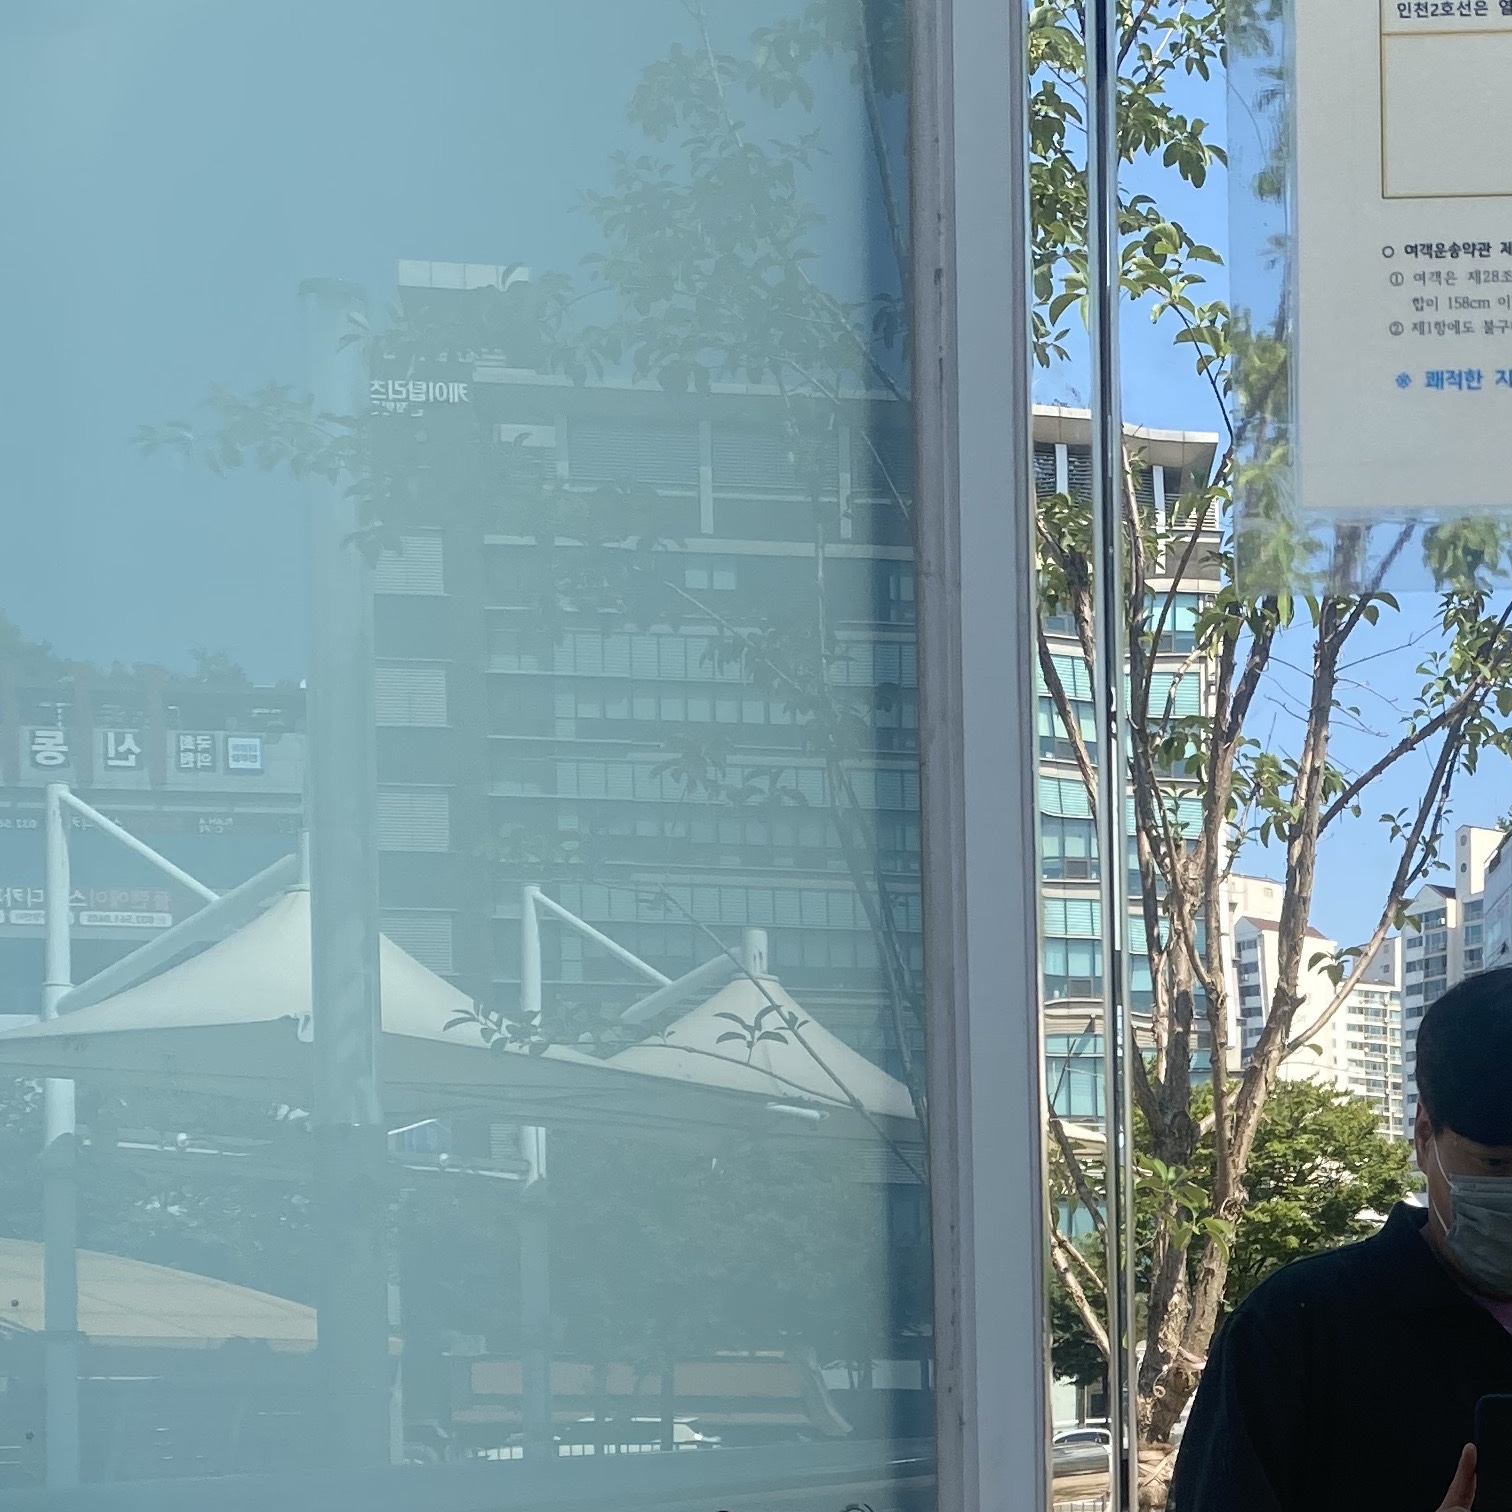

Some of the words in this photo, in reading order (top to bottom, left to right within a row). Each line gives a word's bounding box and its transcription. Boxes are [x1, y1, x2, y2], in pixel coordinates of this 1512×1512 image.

[1404, 242, 1492, 259] 여객운송약관
[1413, 271, 1458, 287] 여객은
[1448, 296, 1490, 310] 158cm
[1412, 320, 1475, 336] 제1항에도
[1425, 368, 1484, 391] 쾌적한
